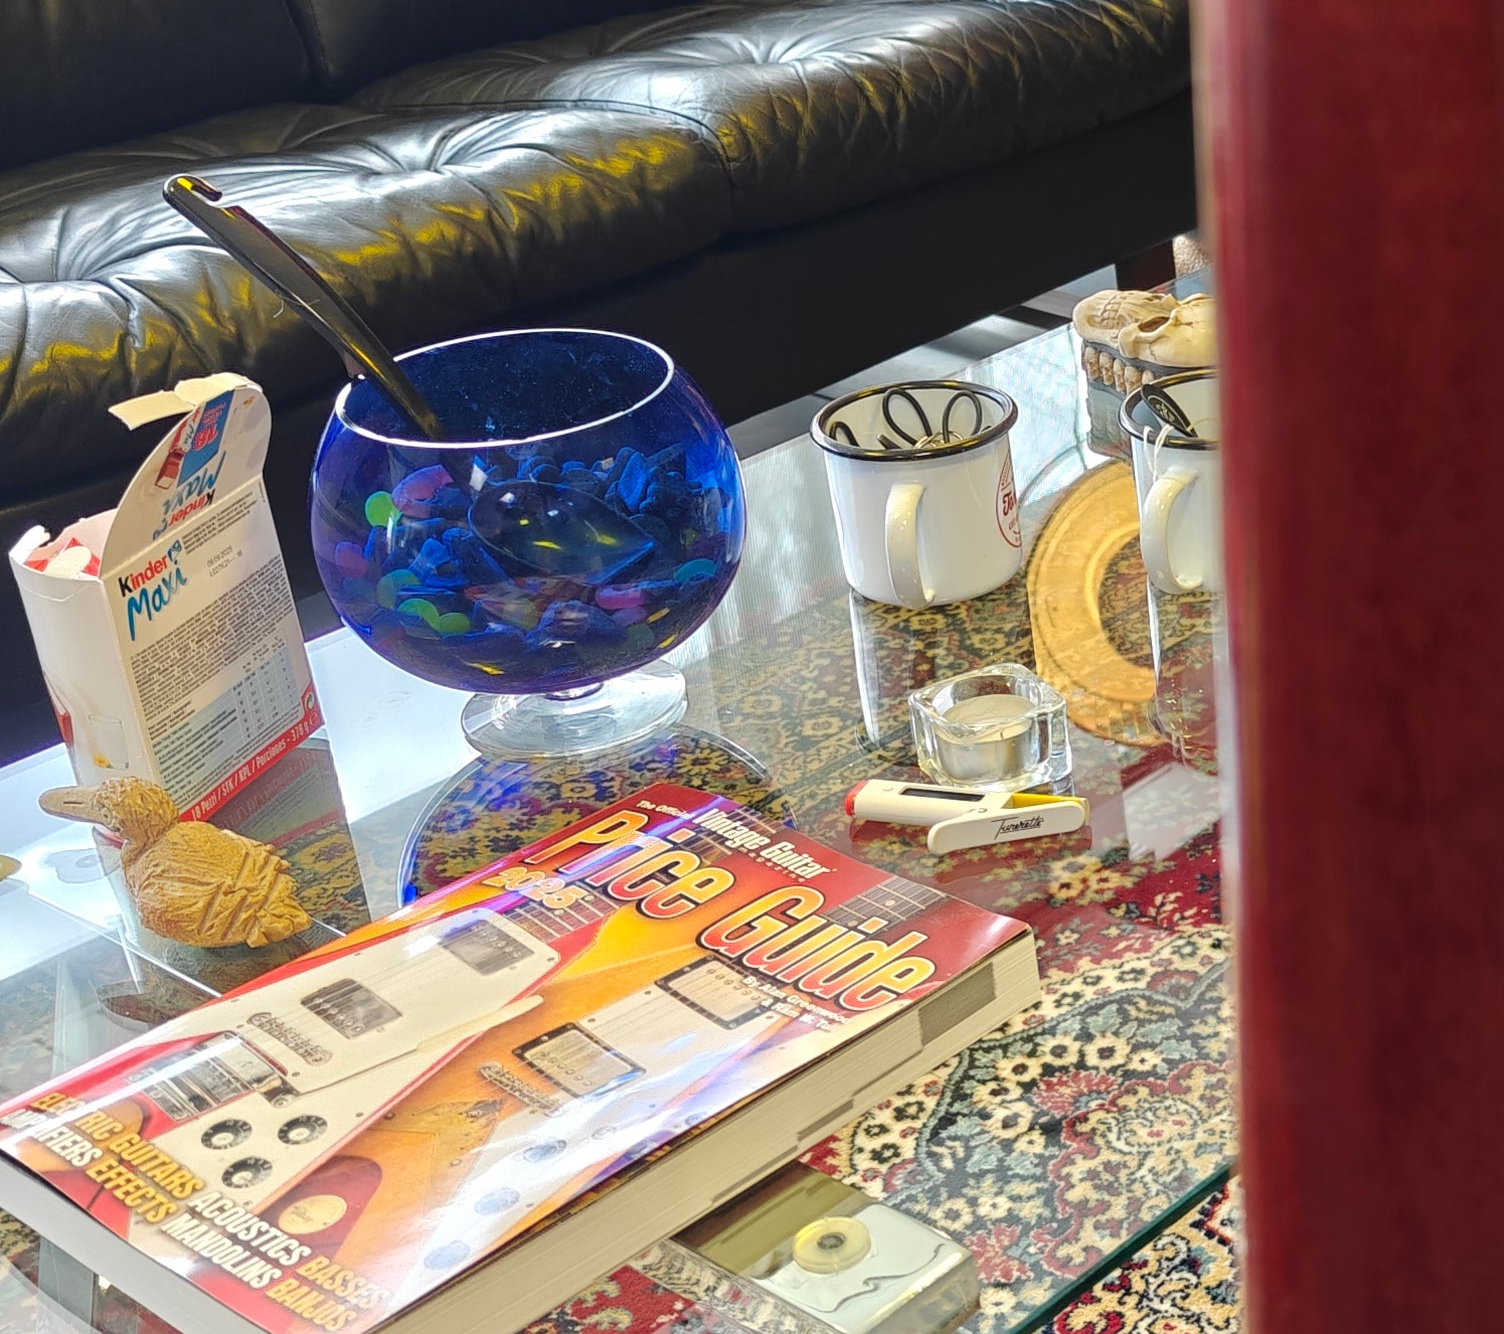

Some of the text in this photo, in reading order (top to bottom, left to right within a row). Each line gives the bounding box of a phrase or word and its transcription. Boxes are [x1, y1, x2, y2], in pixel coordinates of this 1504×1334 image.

[127, 568, 188, 642] Maxi
[221, 780, 237, 798] STK
[255, 739, 288, 768] Porciones
[636, 800, 657, 810] The
[691, 808, 771, 850] Vintage
[759, 841, 831, 879] Guitar
[481, 866, 589, 909] 2025
[522, 810, 938, 1012] Price Guide
[743, 975, 850, 1024] By Alan Greenwood
[761, 998, 774, 1007] &
[86, 1157, 179, 1224] EFFECTS
[160, 1212, 283, 1289] MANDOLINS
[265, 1277, 358, 1332] BANJOS
[108, 1129, 205, 1200] GUITARS
[187, 1191, 311, 1267] ACOUSTICS
[298, 1256, 393, 1311] BASSES
